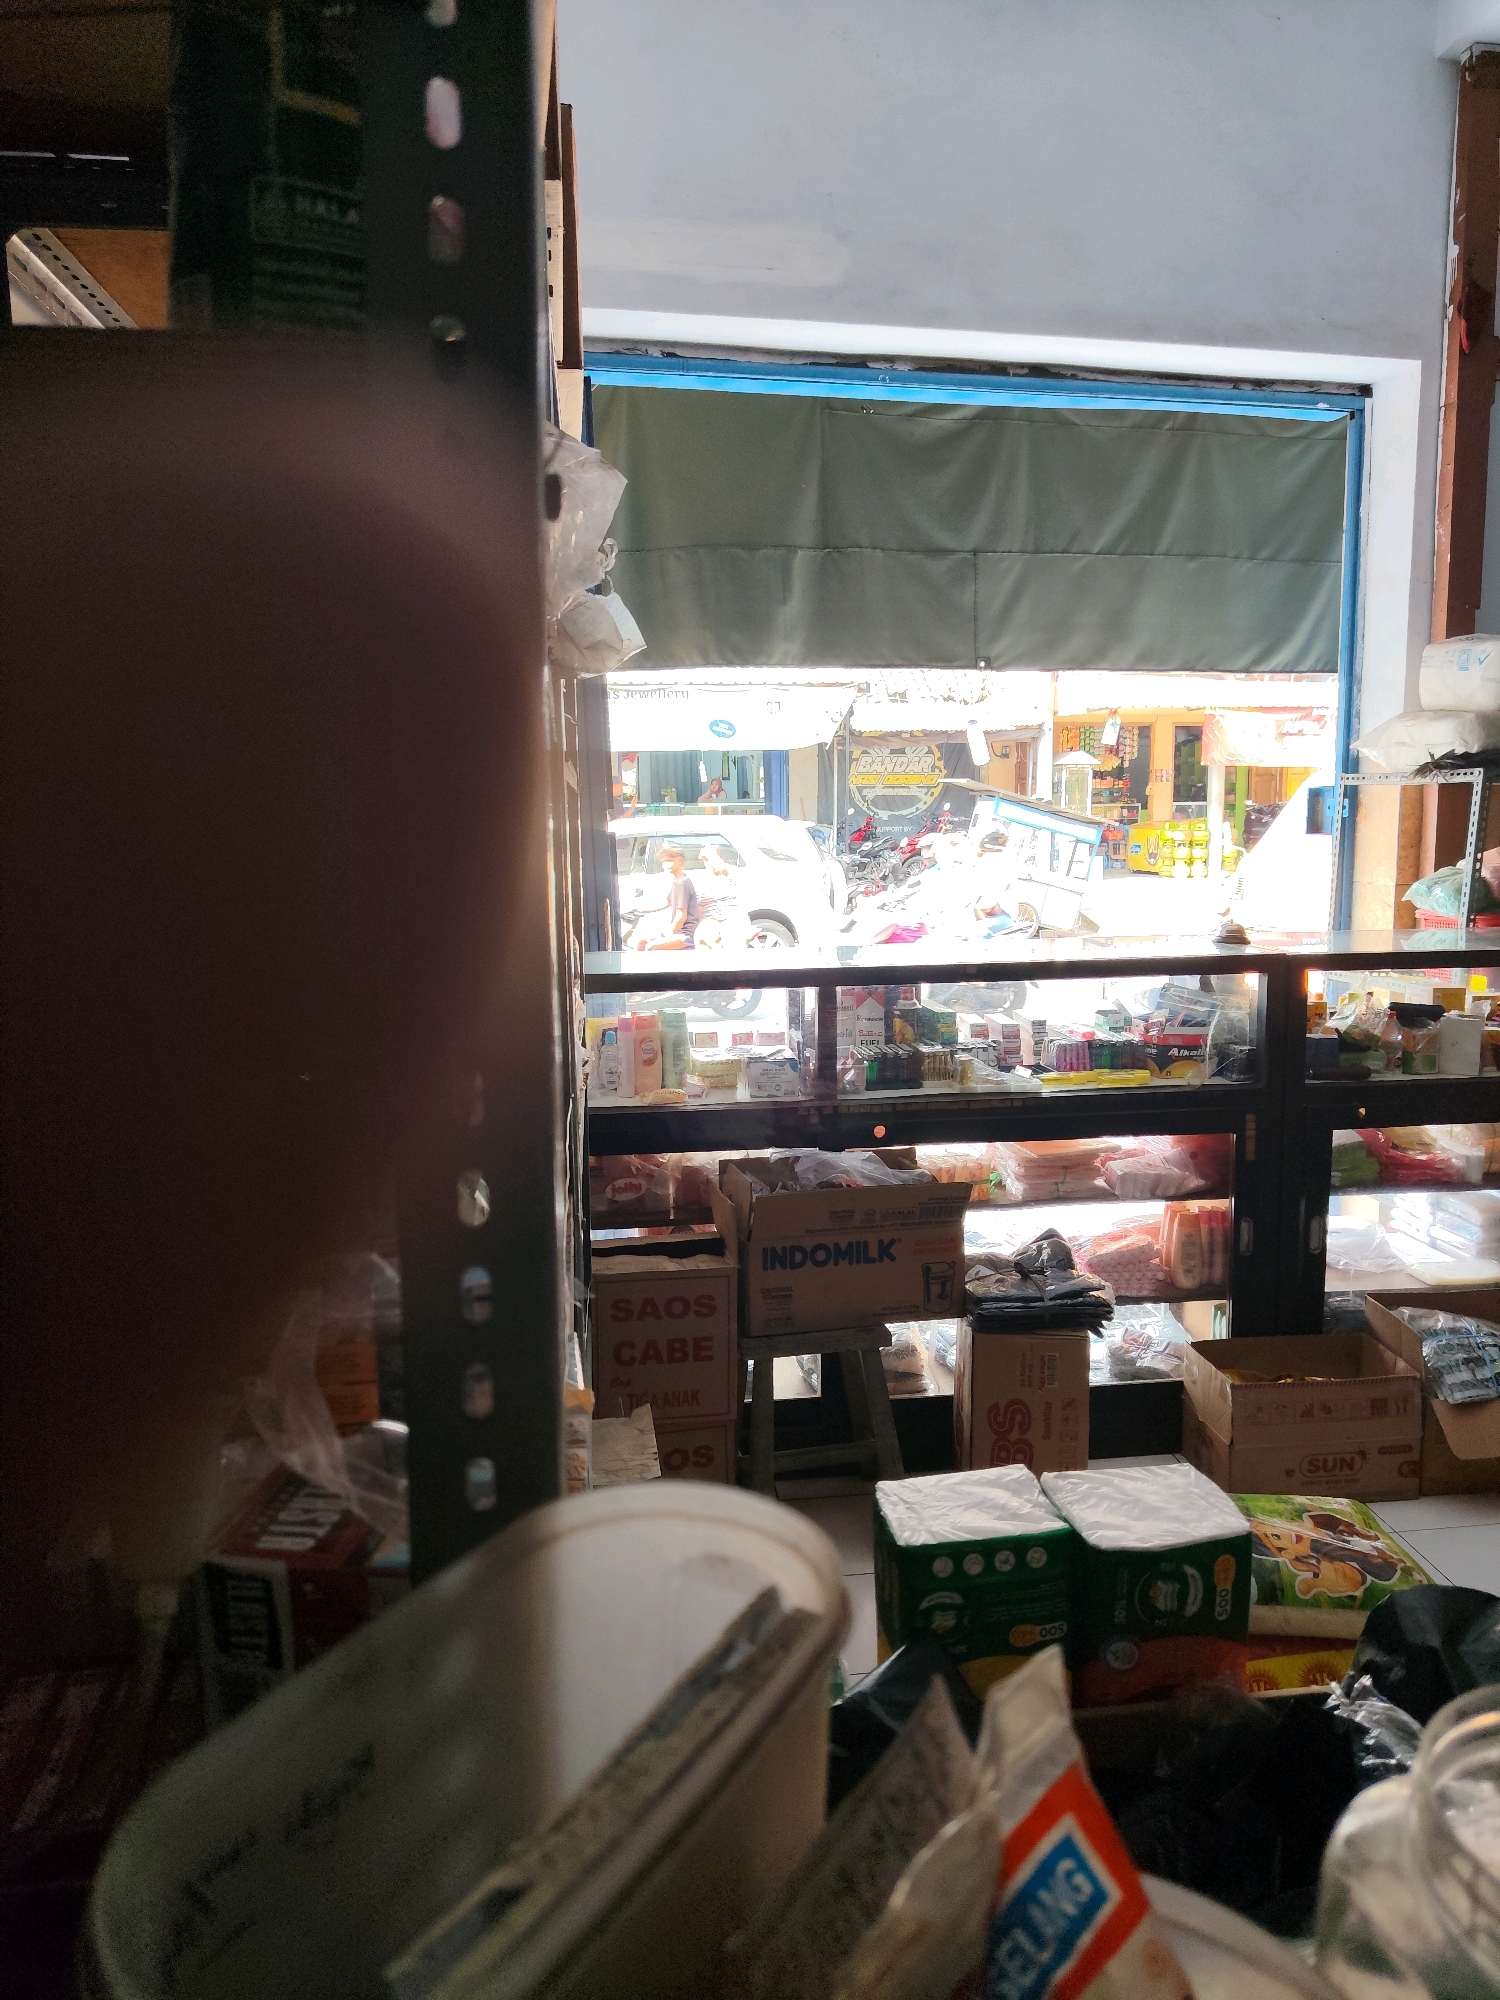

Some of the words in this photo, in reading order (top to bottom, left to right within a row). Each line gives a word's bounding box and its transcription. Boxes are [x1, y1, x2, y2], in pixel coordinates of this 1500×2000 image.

[623, 689, 689, 700] Jewellery
[856, 754, 934, 773] BANDAR
[762, 1239, 897, 1271] INDOMILK
[609, 1293, 717, 1323] SAOS
[612, 1335, 715, 1368] CABE
[662, 1389, 702, 1409] ANAK
[663, 1445, 715, 1472] OS
[1306, 1456, 1356, 1474] SUN
